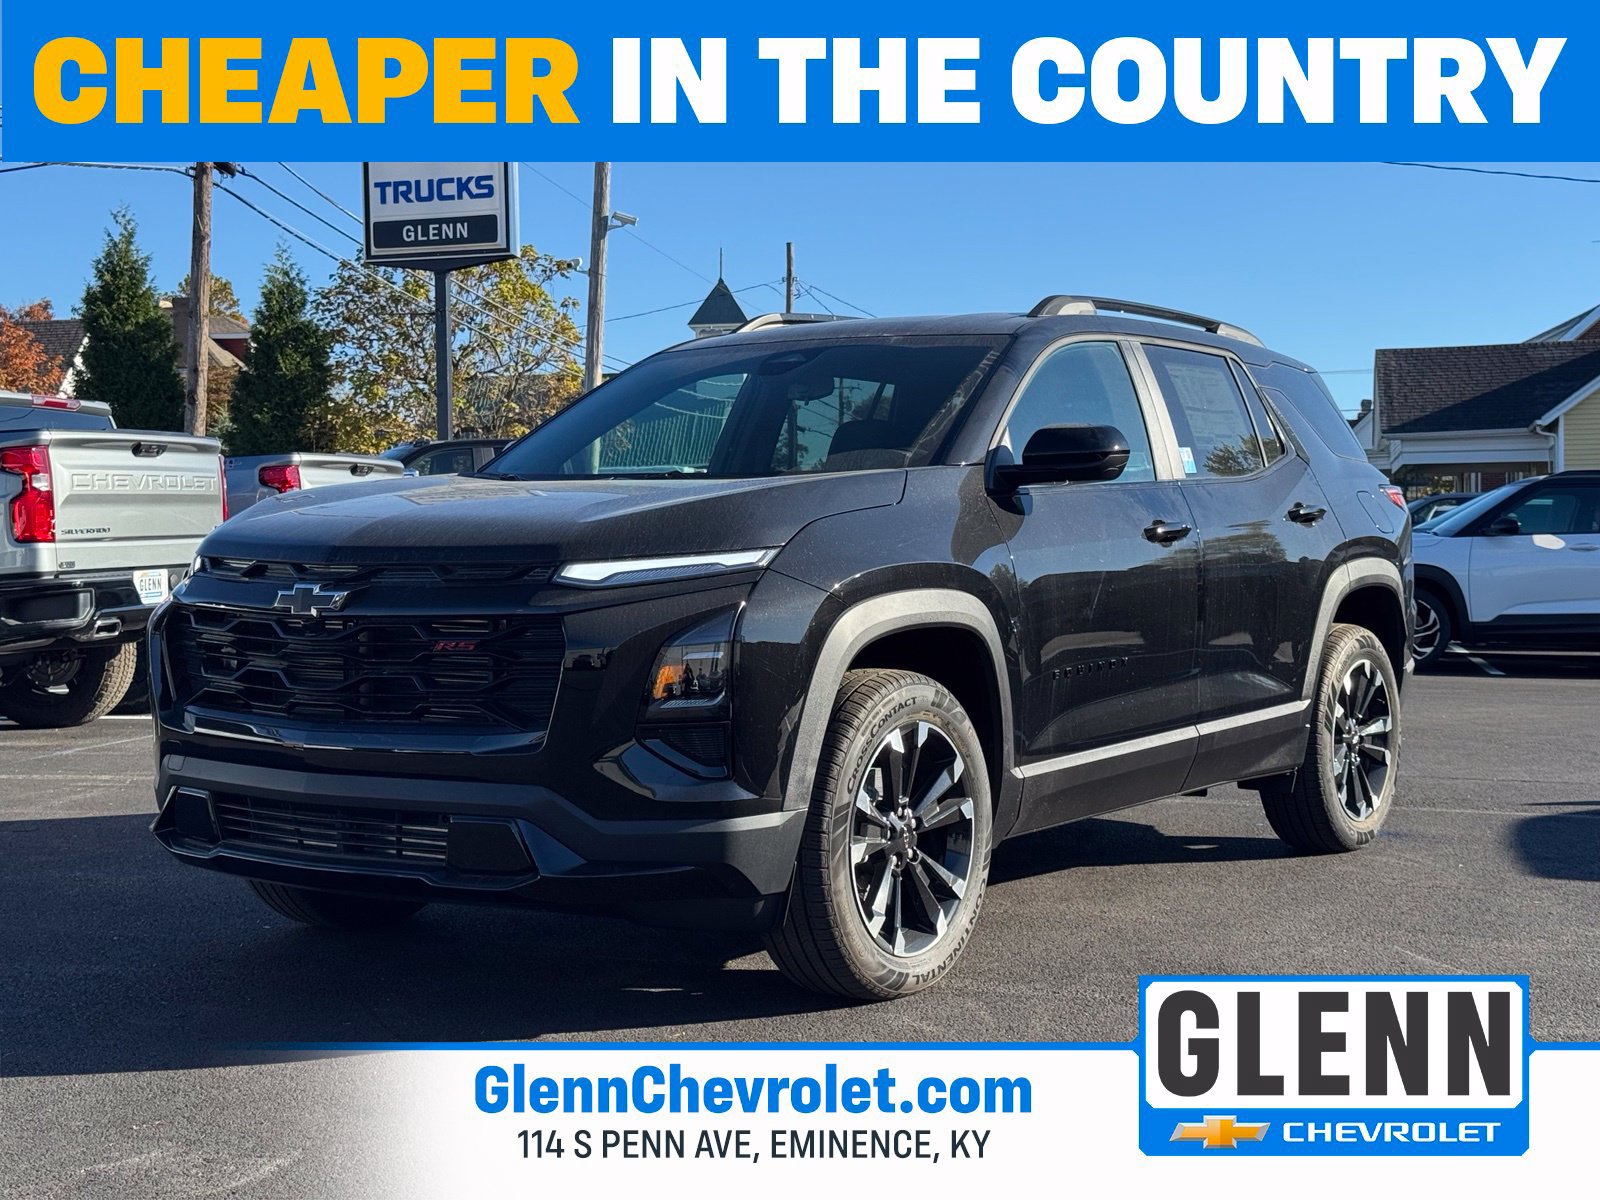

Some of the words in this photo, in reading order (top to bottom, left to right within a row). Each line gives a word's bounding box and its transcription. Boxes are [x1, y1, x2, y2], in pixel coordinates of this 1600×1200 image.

[374, 175, 494, 205] TRUCKS
[402, 222, 468, 242] GLENN
[71, 473, 217, 491] CHEVROLET
[140, 577, 162, 591] GLENN
[434, 640, 477, 651] RS
